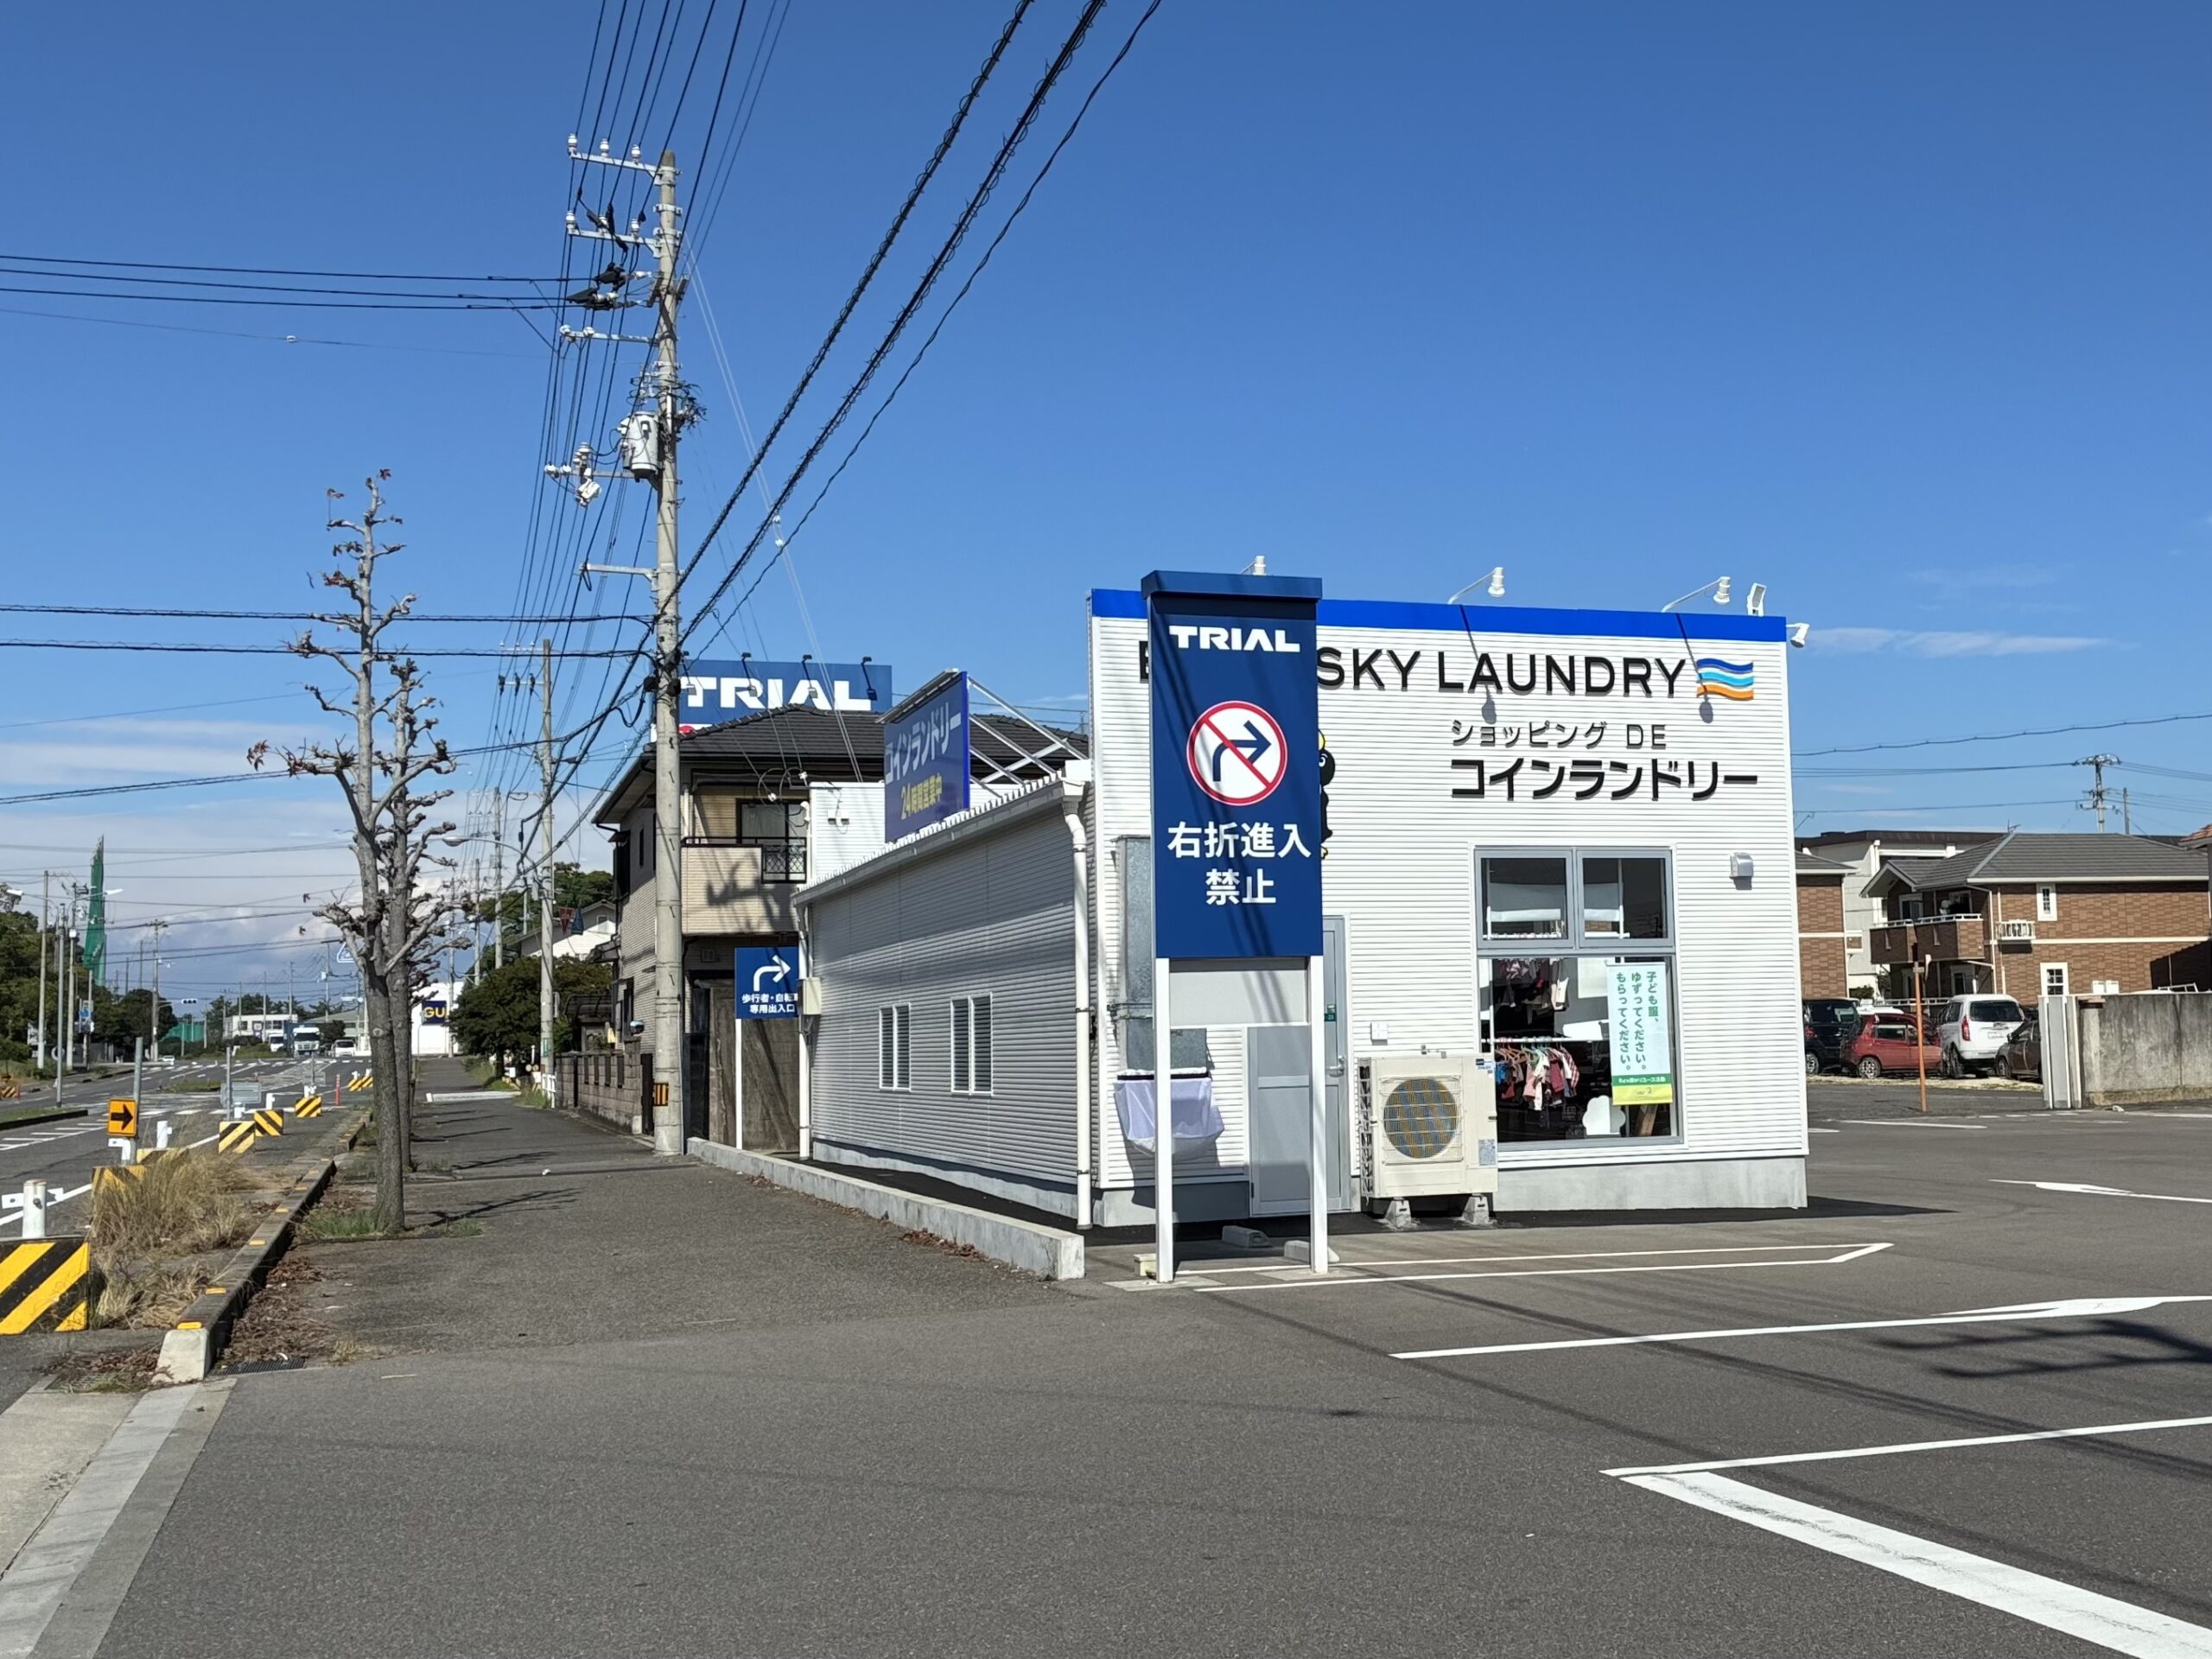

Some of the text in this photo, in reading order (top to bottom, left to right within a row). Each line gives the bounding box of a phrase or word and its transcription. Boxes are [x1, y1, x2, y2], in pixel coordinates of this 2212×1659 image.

[1168, 625, 1301, 652] TRIAL
[1316, 646, 1686, 696] SKY LAUNDRY
[679, 676, 872, 712] TRIAL
[885, 702, 962, 785] コインランドリー
[1452, 720, 1667, 749] ショッピング DE
[1451, 758, 1758, 801] コインランドリー
[1167, 821, 1313, 859] 右折進入
[1205, 868, 1277, 906] 禁止
[423, 1006, 446, 1019] GU
[749, 1003, 795, 1014] 専用出入口
